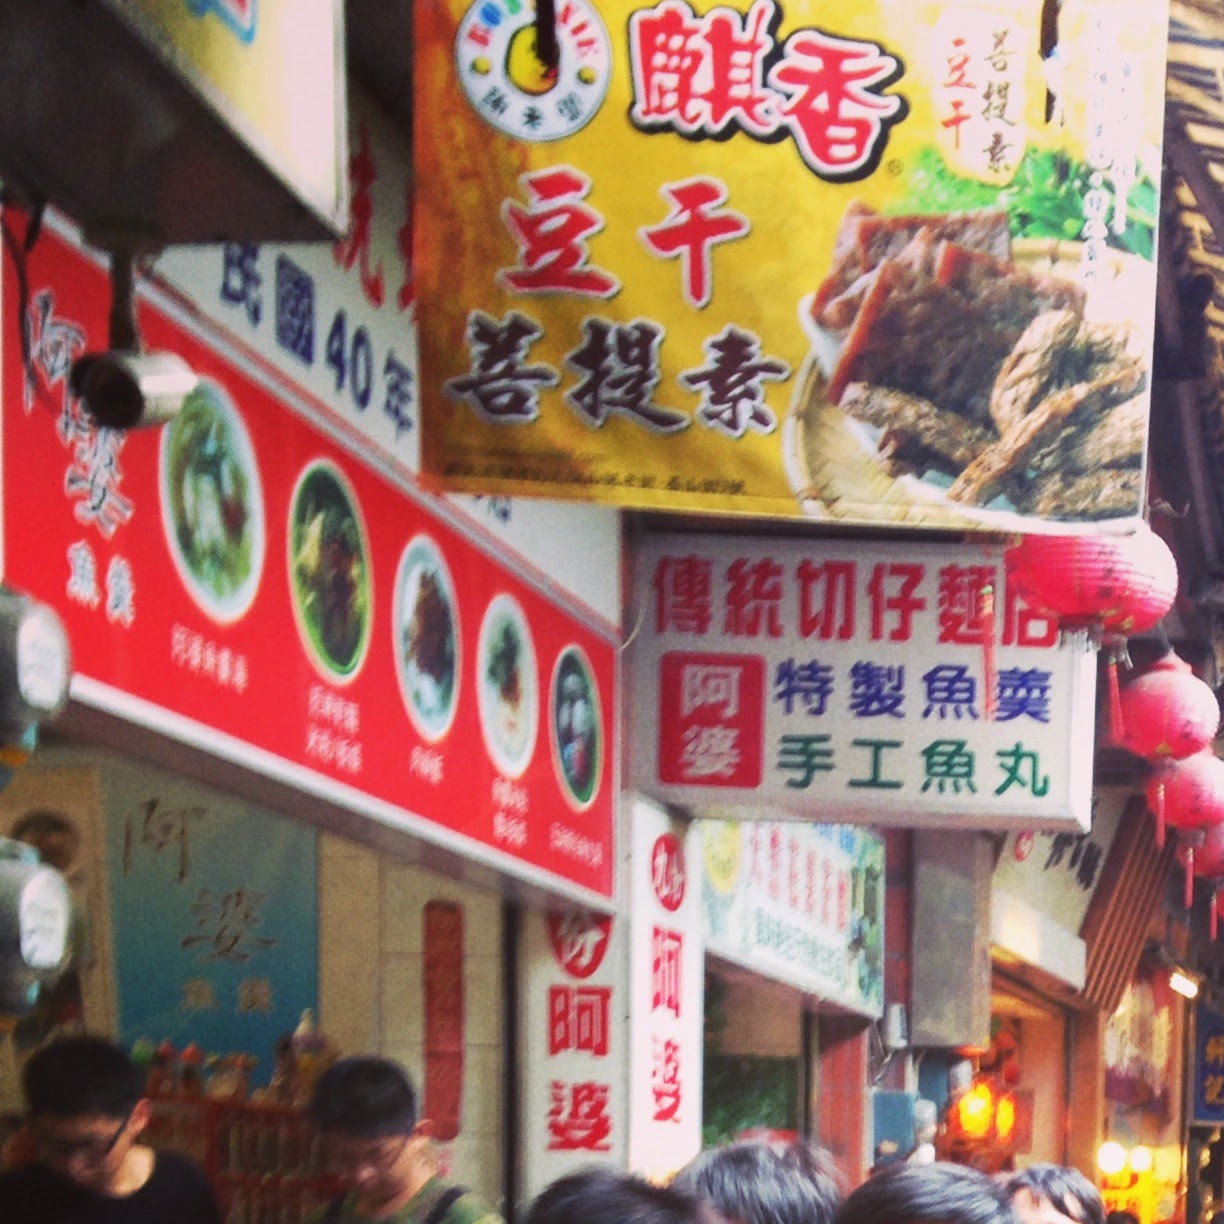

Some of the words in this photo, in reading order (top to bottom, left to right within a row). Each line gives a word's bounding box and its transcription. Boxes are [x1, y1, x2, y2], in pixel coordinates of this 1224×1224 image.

[941, 36, 976, 150] 豆干
[981, 29, 1018, 173] 菩提素
[500, 164, 750, 309] 豆干
[445, 311, 789, 438] 菩提素
[679, 663, 744, 780] 阿婆
[775, 657, 1052, 723] 特製魚羹
[775, 732, 1051, 799] 手工魚丸
[547, 984, 613, 1153] 阿婆
